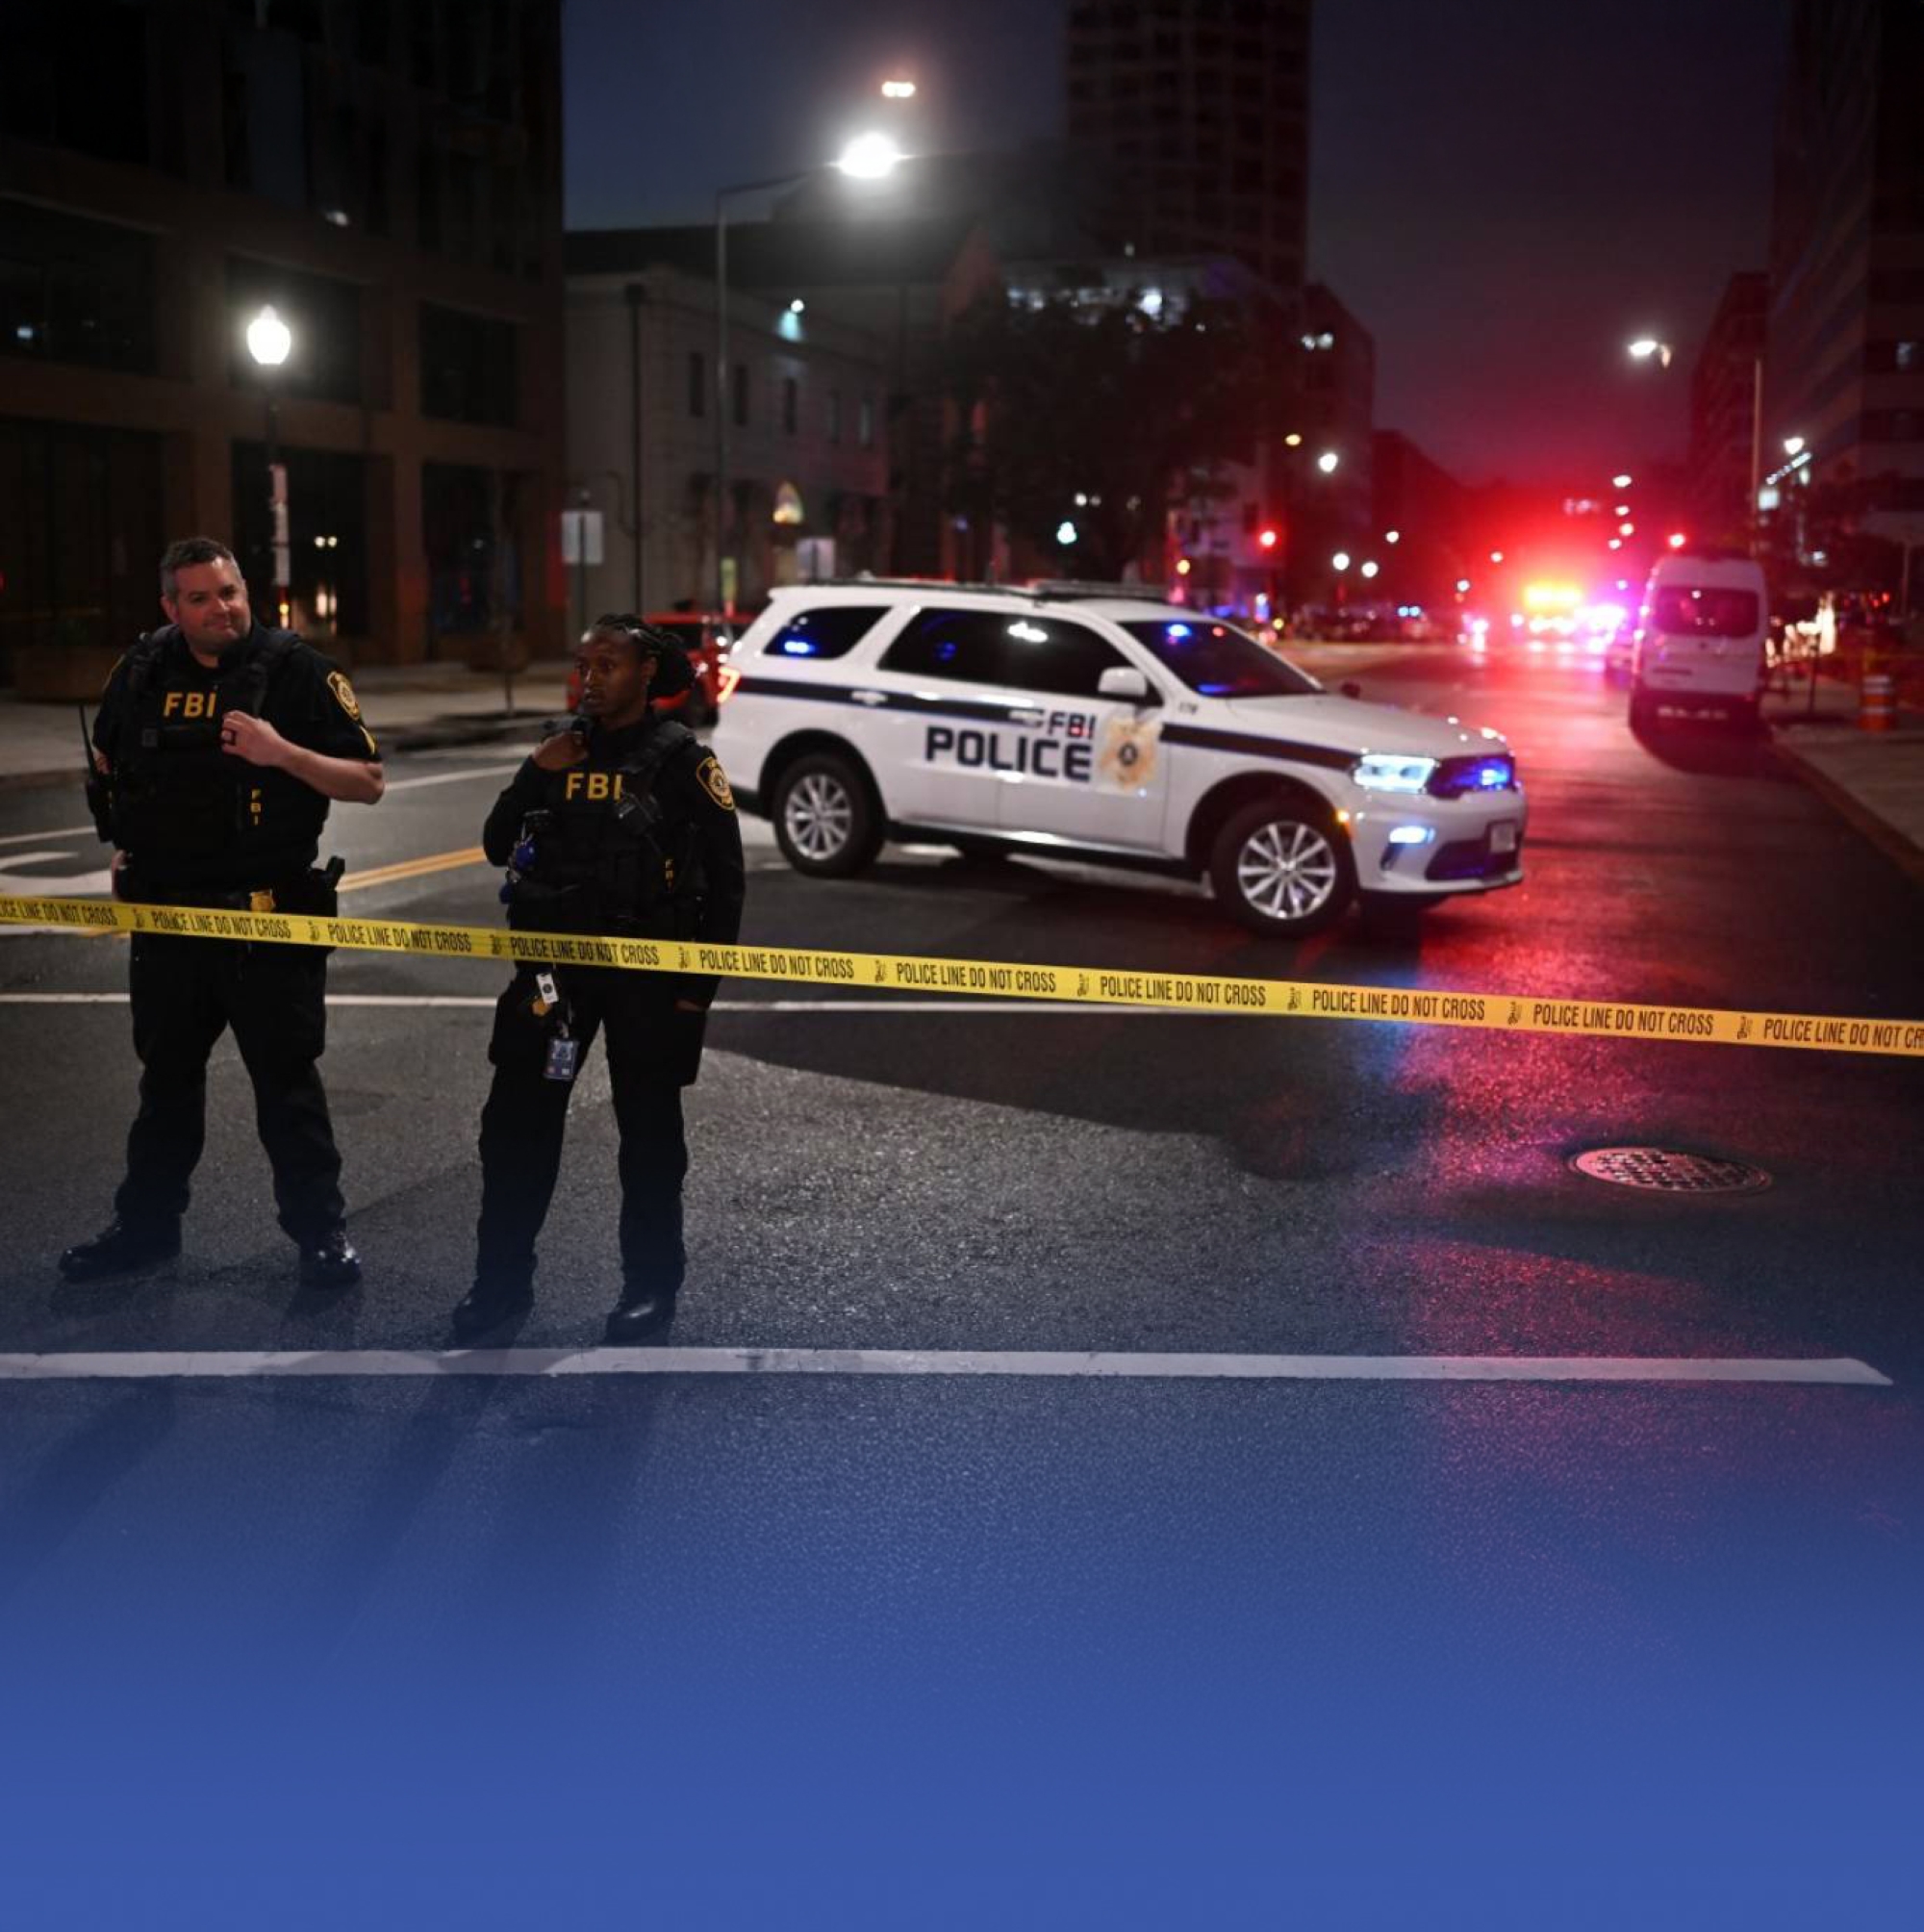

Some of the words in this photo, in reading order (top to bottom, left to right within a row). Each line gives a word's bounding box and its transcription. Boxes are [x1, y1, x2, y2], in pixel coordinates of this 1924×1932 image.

[163, 691, 216, 719] FBI
[1047, 710, 1097, 740] FBI
[924, 725, 1093, 782] POLICE
[565, 773, 623, 801] FBI
[214, 915, 231, 935] DO
[231, 916, 253, 937] NOT
[254, 918, 291, 939] CROSS
[327, 923, 366, 944] POLICE
[367, 925, 394, 946] LINE
[392, 926, 410, 948] DO
[411, 928, 432, 950] NOT
[434, 929, 471, 953] CROSS
[510, 936, 550, 957] POLICE
[550, 938, 576, 960] LINE
[578, 941, 595, 961] DO
[596, 942, 619, 963] NOT
[620, 944, 660, 965] CROSS
[699, 949, 740, 971] POLICE
[741, 951, 768, 973] LINE
[770, 953, 787, 975] DO
[789, 954, 813, 976] NOT
[815, 955, 854, 979] CROSS
[897, 962, 937, 984] POLICE
[940, 964, 967, 986] LINE
[970, 967, 986, 988] DO
[989, 968, 1012, 990] NOT
[1015, 969, 1056, 993] CROSS
[1100, 976, 1142, 999] POLICE
[1146, 978, 1173, 1001] LINE
[1176, 980, 1193, 1003] DO
[1197, 981, 1220, 1004] NOT
[1225, 982, 1266, 1006] CROSS
[1312, 989, 1355, 1012] POLICE
[1359, 992, 1387, 1015] LINE
[1391, 994, 1409, 1015] DO
[1412, 995, 1438, 1018] NOT
[1442, 997, 1485, 1021] CROSS
[1533, 1004, 1579, 1027] POLICE
[1582, 1006, 1612, 1030] LINE
[1615, 1008, 1634, 1030] DO
[1637, 1009, 1665, 1032] NOT
[1668, 1010, 1714, 1036] CROSS
[1763, 1018, 1812, 1041] POLICE
[1814, 1020, 1847, 1044] LINE
[1849, 1022, 1869, 1046] DO
[1872, 1023, 1904, 1049] NOT
